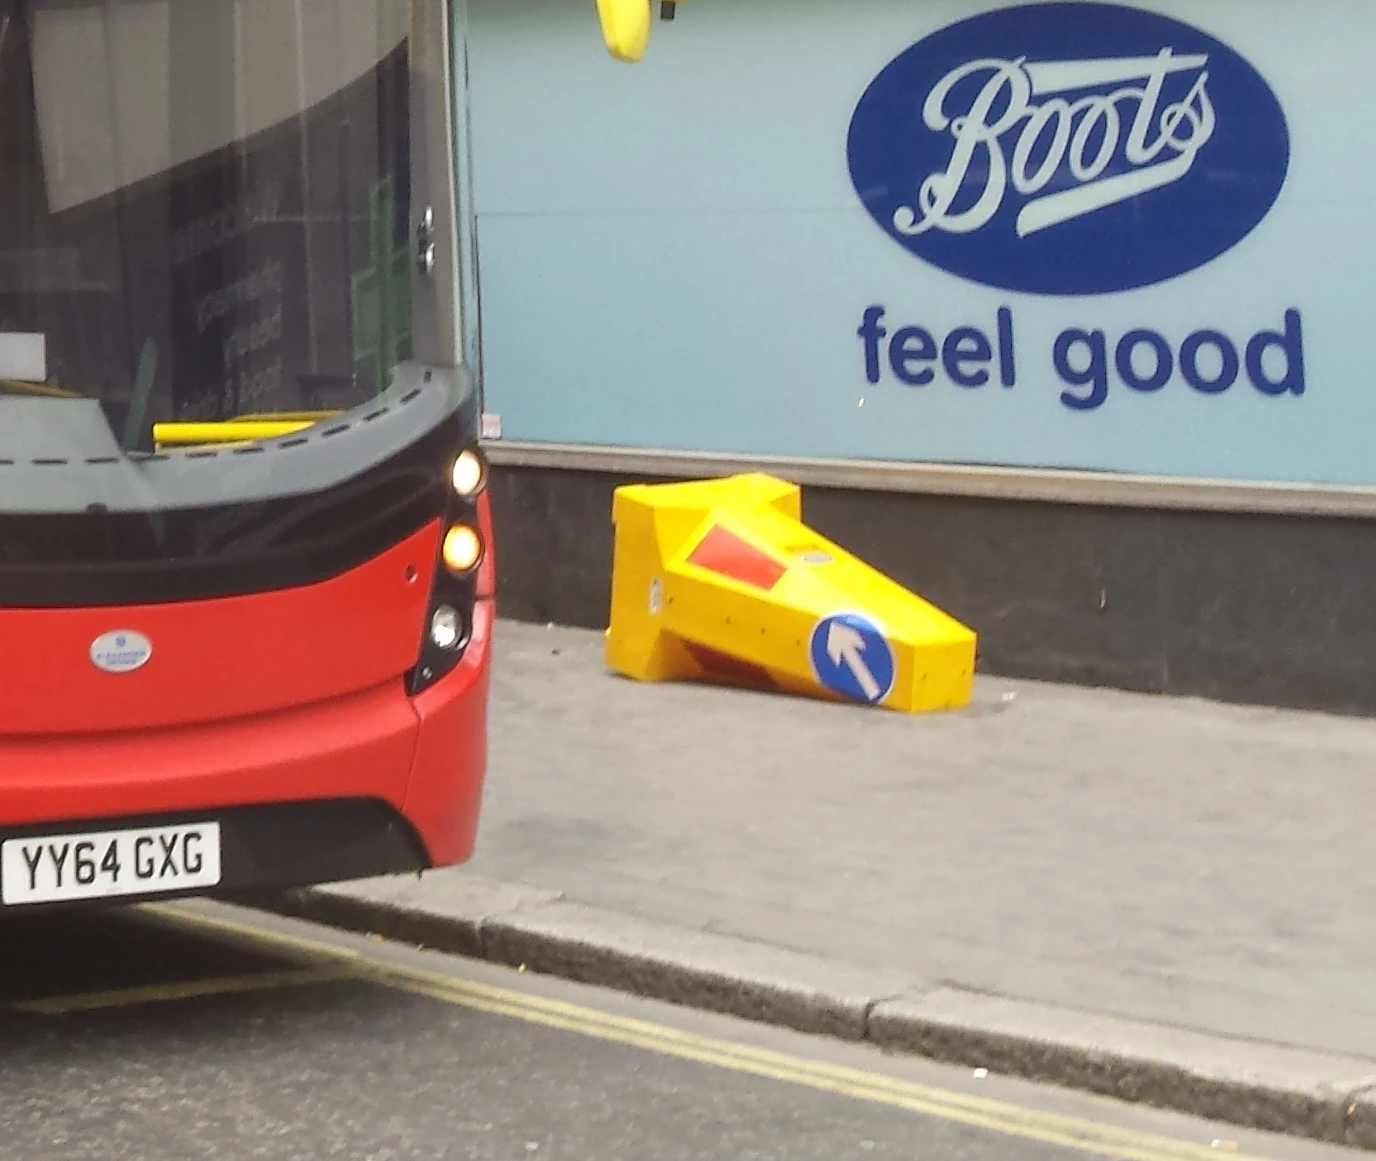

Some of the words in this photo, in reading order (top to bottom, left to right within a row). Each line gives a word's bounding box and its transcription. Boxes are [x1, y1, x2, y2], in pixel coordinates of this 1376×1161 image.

[893, 46, 1216, 238] Boots
[857, 306, 1016, 388] feel
[1052, 308, 1306, 411] good
[21, 837, 122, 890] YY64
[134, 831, 203, 879] GXG
